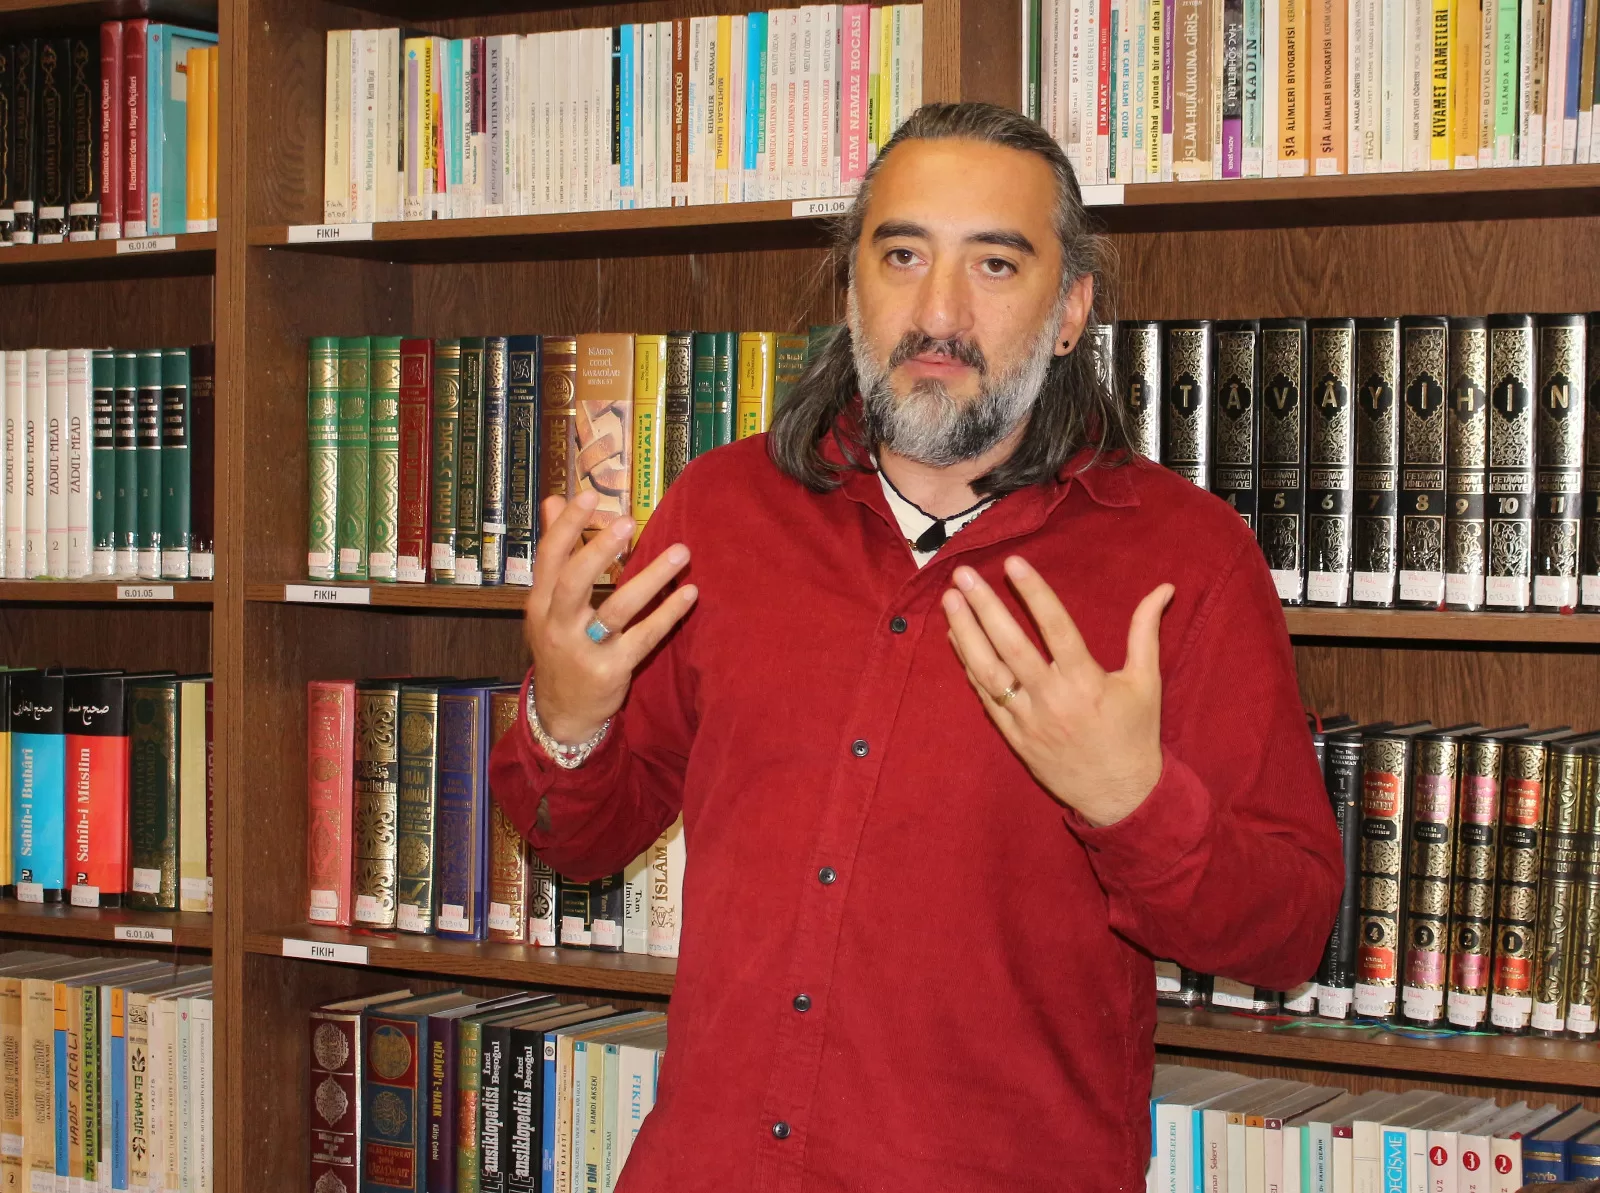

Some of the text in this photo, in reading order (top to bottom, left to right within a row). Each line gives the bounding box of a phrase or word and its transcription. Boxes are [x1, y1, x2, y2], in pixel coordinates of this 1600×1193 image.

[1072, 8, 1080, 40] Bakış
[1151, 11, 1160, 31] daha
[771, 33, 779, 76] MEVLÜT ÖZCAN
[824, 29, 832, 72] MEVLÜT ÖZCAN
[1136, 24, 1145, 68] TERBİYESİ
[1151, 36, 1160, 56] adım
[1151, 59, 1160, 71] bir
[1227, 23, 1237, 100] HAC SOHBETLERİ
[1245, 38, 1257, 101] KADIN
[1432, 9, 1448, 138] KIYAMET ALAMETLERİ
[1481, 43, 1491, 106] BÜYÜK DUÂ
[1121, 39, 1130, 138] TEK ÇARE ÇÖZÜM
[1136, 71, 1145, 103] ÇOCUK
[1182, 13, 1200, 162] İSLÂM HUKUKUNA GİRİŞ
[1282, 0, 1300, 157] ŞİA ÂLİMLERİ BİYOGRAFİSİ KERİM
[1319, 15, 1334, 153] ŞİA ÂLİMLERİ BİYOGRAFİSİ KERİM
[1353, 72, 1361, 98] ÖĞRETİSİ
[1412, 70, 1420, 97] ÖĞRETİSİ
[425, 88, 432, 96] VE
[674, 72, 684, 124] BAŞÖRTÜSÜ
[848, 14, 862, 172] TAM NAMAZ HOCASI
[1151, 75, 1160, 110] yolunda
[1500, 72, 1510, 116] İSLÂMDA
[490, 101, 498, 140] KULLUK
[716, 77, 724, 159] MUHTASAR İLMİHAL
[1136, 106, 1144, 120] DA
[1086, 155, 1093, 167] 65
[809, 201, 846, 214] F.01.06
[316, 227, 340, 238] FIKIH
[1130, 384, 1140, 406] E
[1179, 385, 1192, 408] T
[1226, 383, 1241, 410] Â
[1272, 386, 1290, 410] V
[1320, 380, 1339, 408] Â
[1368, 386, 1383, 410] Y
[1456, 387, 1474, 412] H
[1550, 385, 1568, 409] N
[462, 441, 475, 484] EKBER
[643, 413, 652, 508] İLMİHALİ
[1273, 492, 1285, 509] 5
[1321, 494, 1334, 509] 6
[1369, 495, 1380, 512] 7
[1416, 494, 1430, 512] 8
[1456, 498, 1468, 515] 9
[1498, 497, 1519, 514] 10
[1550, 496, 1564, 514] 11
[315, 522, 322, 533] 2
[52, 542, 59, 551] 2
[313, 590, 337, 600] FIKIH
[21, 747, 34, 857] Sahîh-i Buhârî
[77, 748, 91, 862] Sahîh-i Müslim
[651, 846, 669, 902] İSLÂM
[625, 882, 634, 920] İlmihal
[634, 889, 644, 913] Tam
[1369, 923, 1379, 939] 4
[1420, 924, 1428, 940] 3
[1464, 926, 1473, 945] 2
[1507, 934, 1516, 949] 1
[311, 946, 335, 958] FIKIH
[1543, 946, 1556, 961] 7
[482, 1052, 491, 1076] İnci
[490, 1040, 502, 1085] Beşoğul
[514, 1056, 524, 1080] İnci
[524, 1045, 535, 1089] Beşoğul
[66, 1028, 79, 1146] HADİS RİCÂLİ
[84, 990, 95, 1174] 75 KUDSİ HADİS TERCÜMESİ
[134, 1075, 145, 1135] EL MAARİF
[631, 1074, 642, 1120] FIKIH
[482, 1086, 504, 1173] ansiklopedisi
[512, 1090, 536, 1178] ansiklopedisi
[586, 1075, 598, 1184] DİNİ HAMDİ AKSEKİ
[1270, 1120, 1276, 1128] 6
[1168, 1122, 1177, 1176] MESELELERİ
[1432, 1148, 1443, 1164] 4
[1466, 1152, 1475, 1169] 3
[1499, 1156, 1508, 1172] 2
[8, 1173, 16, 1186] 2
